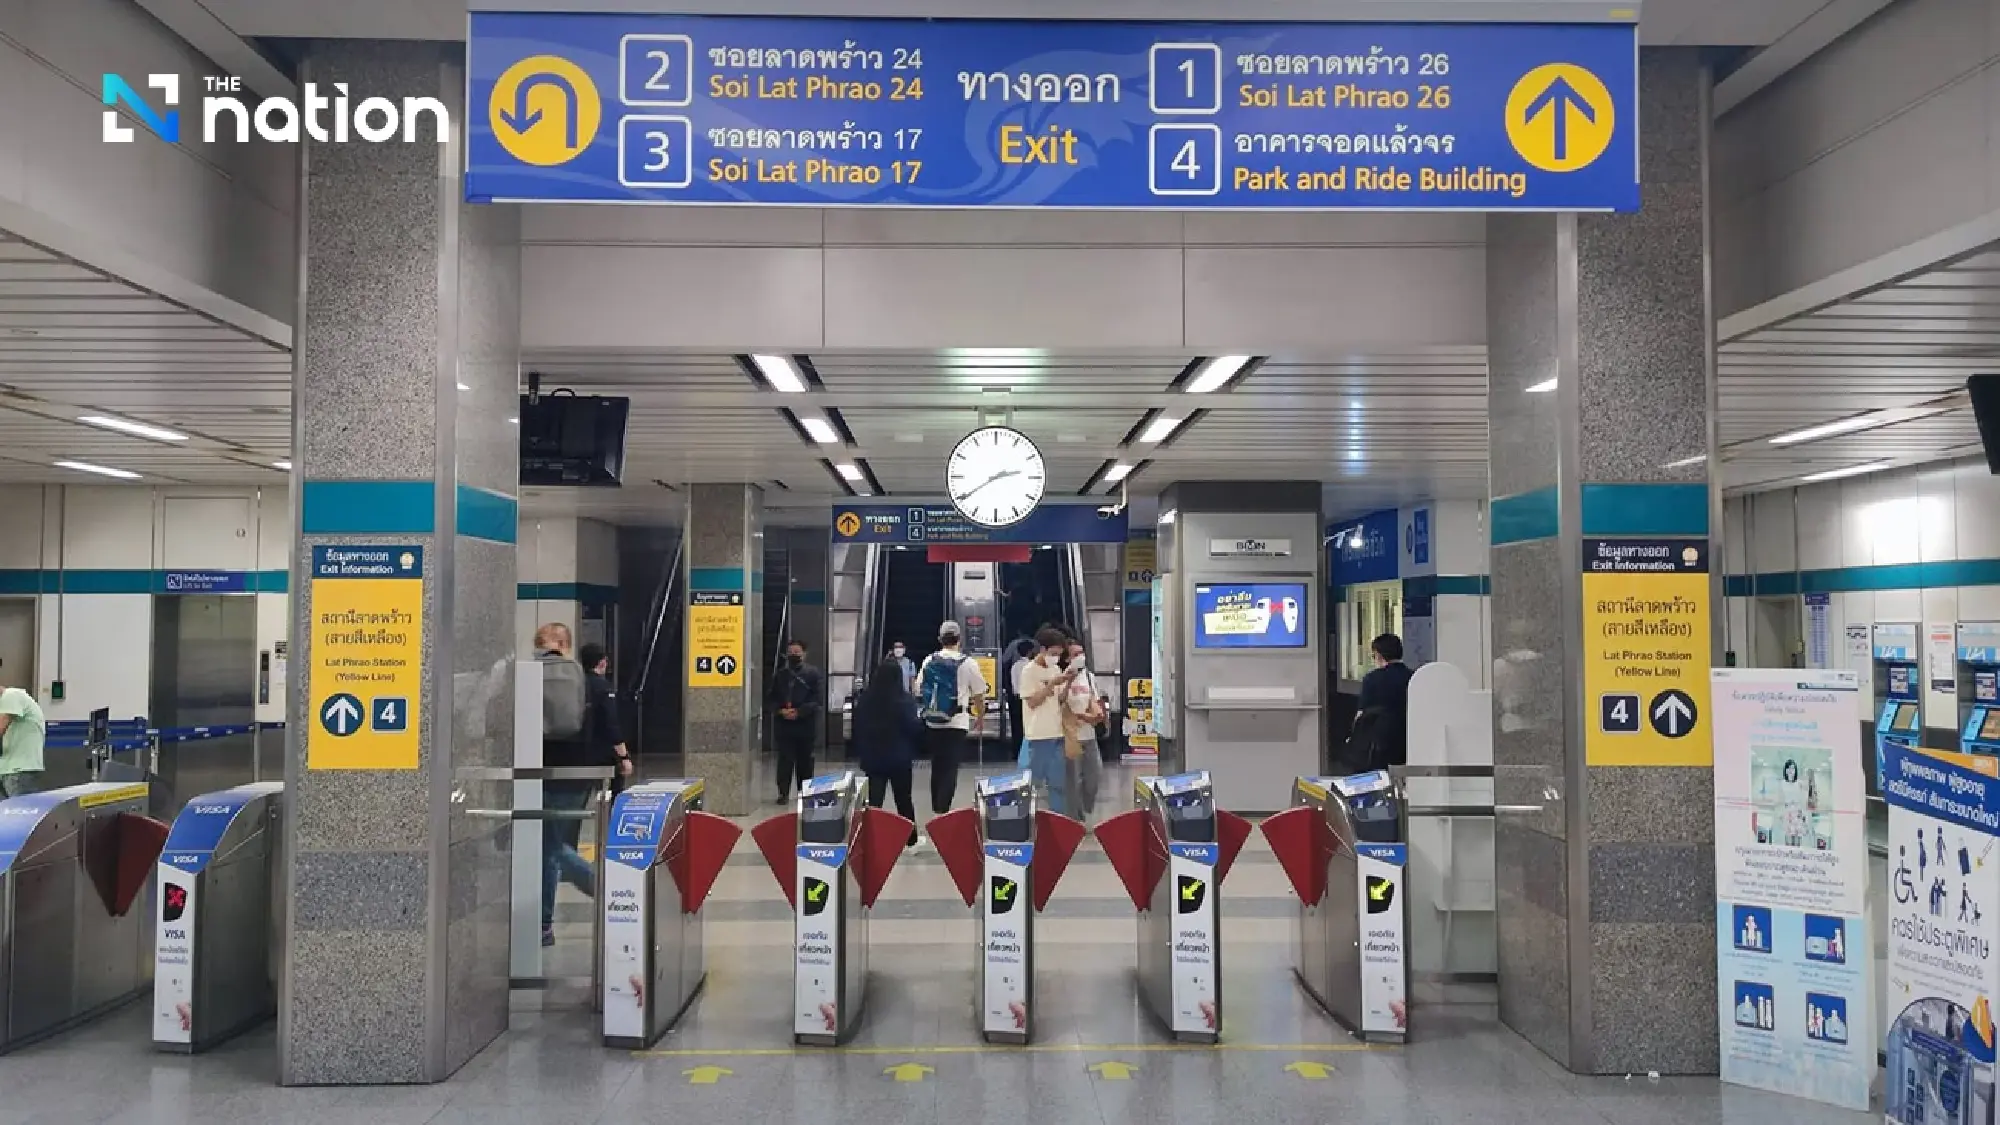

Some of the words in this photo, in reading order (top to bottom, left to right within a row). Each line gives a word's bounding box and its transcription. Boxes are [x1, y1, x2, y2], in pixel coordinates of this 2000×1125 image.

[708, 41, 883, 69] ซอยลาดพร้าว
[893, 49, 923, 69] 24
[1237, 47, 1410, 75] ซอยลาดพร้าว
[1418, 54, 1450, 75] 26
[644, 51, 670, 90] 2
[1178, 60, 1195, 98] 1
[709, 76, 749, 99] Soi
[758, 76, 797, 99] Lat
[806, 76, 880, 101] Phrao
[890, 79, 924, 100] 24
[957, 69, 1121, 102] ทางออก
[1240, 84, 1278, 107] Soi
[1287, 84, 1327, 107] Lat
[1334, 84, 1409, 109] Phrao
[1417, 86, 1450, 108] 26
[708, 121, 883, 150] ซอยลาดพร้าว
[893, 129, 923, 150] 17
[1000, 124, 1079, 164] Exit
[1234, 125, 1456, 154] อาคารจอดแล้วจร
[643, 131, 670, 172] 3
[1170, 140, 1201, 180] 4
[708, 159, 749, 182] Soi
[758, 159, 797, 183] Lat
[806, 159, 880, 184] Phrao
[890, 161, 923, 184] 17
[1233, 168, 1289, 190] Park
[1296, 168, 1343, 190] and
[1354, 168, 1412, 190] Ride
[1420, 168, 1527, 196] Building
[874, 525, 892, 533] Exit
[321, 565, 338, 574] Exit
[341, 565, 393, 574] Information
[1592, 562, 1613, 571] Exit
[1614, 561, 1676, 571] Information
[1597, 597, 1696, 614] สถานีลาดพร้าว
[1602, 619, 1692, 637] (สายสีเหลือง)
[325, 658, 341, 667] Lat
[343, 658, 371, 667] Phrao
[373, 658, 406, 667] Station
[700, 659, 708, 669] 4
[1604, 651, 1620, 660] Lat
[1622, 651, 1653, 661] Phrao
[1656, 651, 1692, 661] Station
[334, 673, 370, 682] (Yellow
[371, 673, 396, 682] Line)
[1614, 667, 1652, 677] (Yellow
[1654, 667, 1681, 678] Line)
[380, 702, 396, 723] 4
[1610, 699, 1629, 723] 4
[1948, 771, 1985, 801] ผู้สูงอายุ
[618, 851, 643, 860] VISA
[810, 850, 834, 858] VISA
[997, 849, 1022, 857] VISA
[1182, 849, 1208, 857] VISA
[1370, 849, 1395, 857] VISA
[164, 930, 186, 939] VISA
[1892, 913, 1989, 959] ควรใช้ประตูพิเศษ
